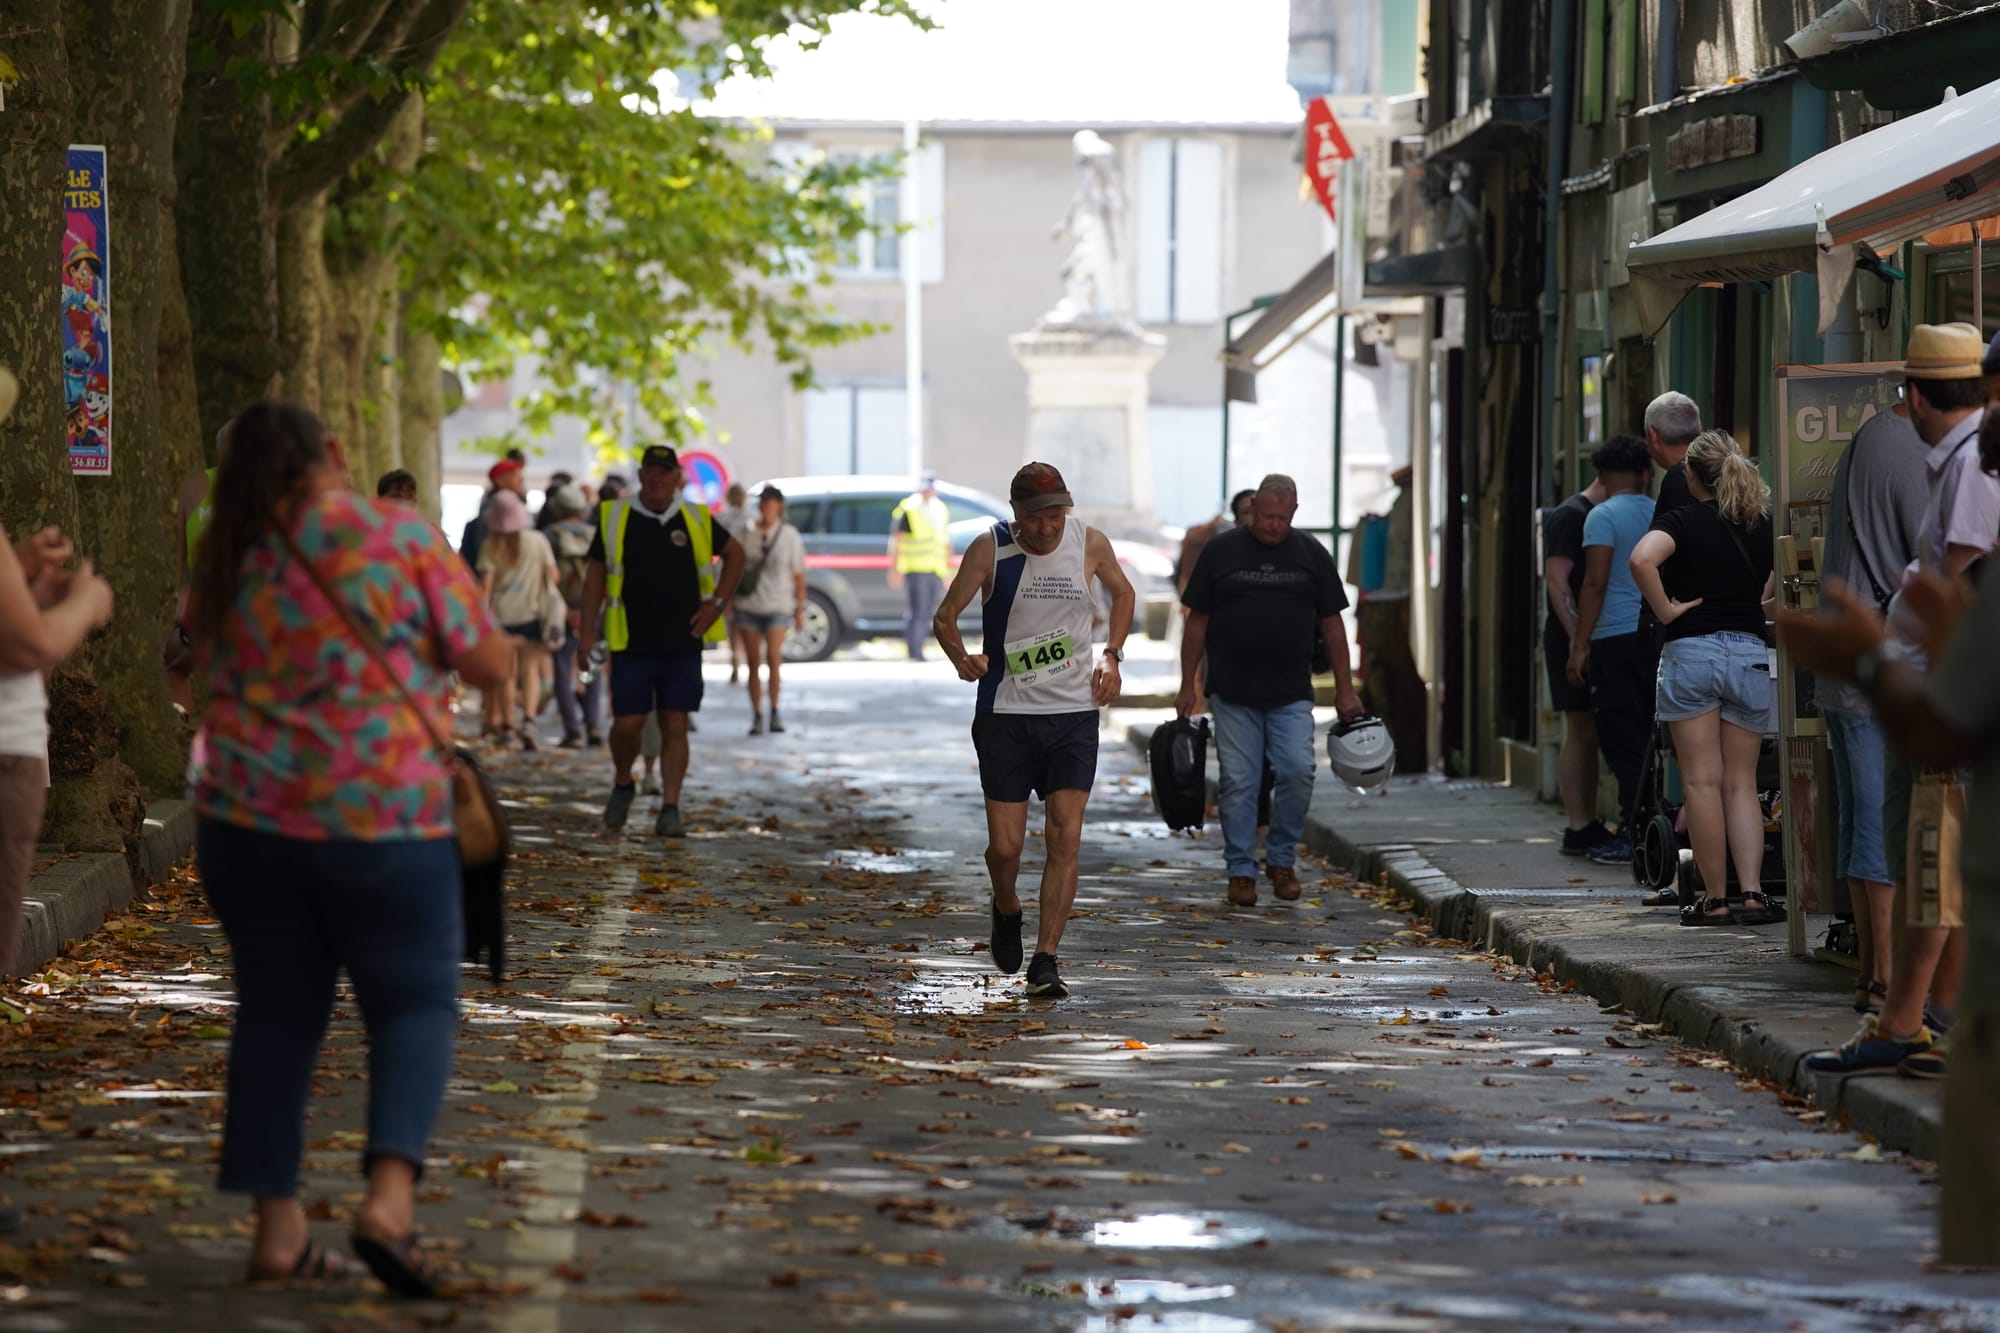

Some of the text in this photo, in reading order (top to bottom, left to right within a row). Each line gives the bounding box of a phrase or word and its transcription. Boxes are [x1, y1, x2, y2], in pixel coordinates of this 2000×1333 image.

[67, 169, 92, 188] LE
[64, 190, 102, 209] TES
[71, 457, 106, 468] .56.88.55
[1019, 642, 1065, 670] 146
